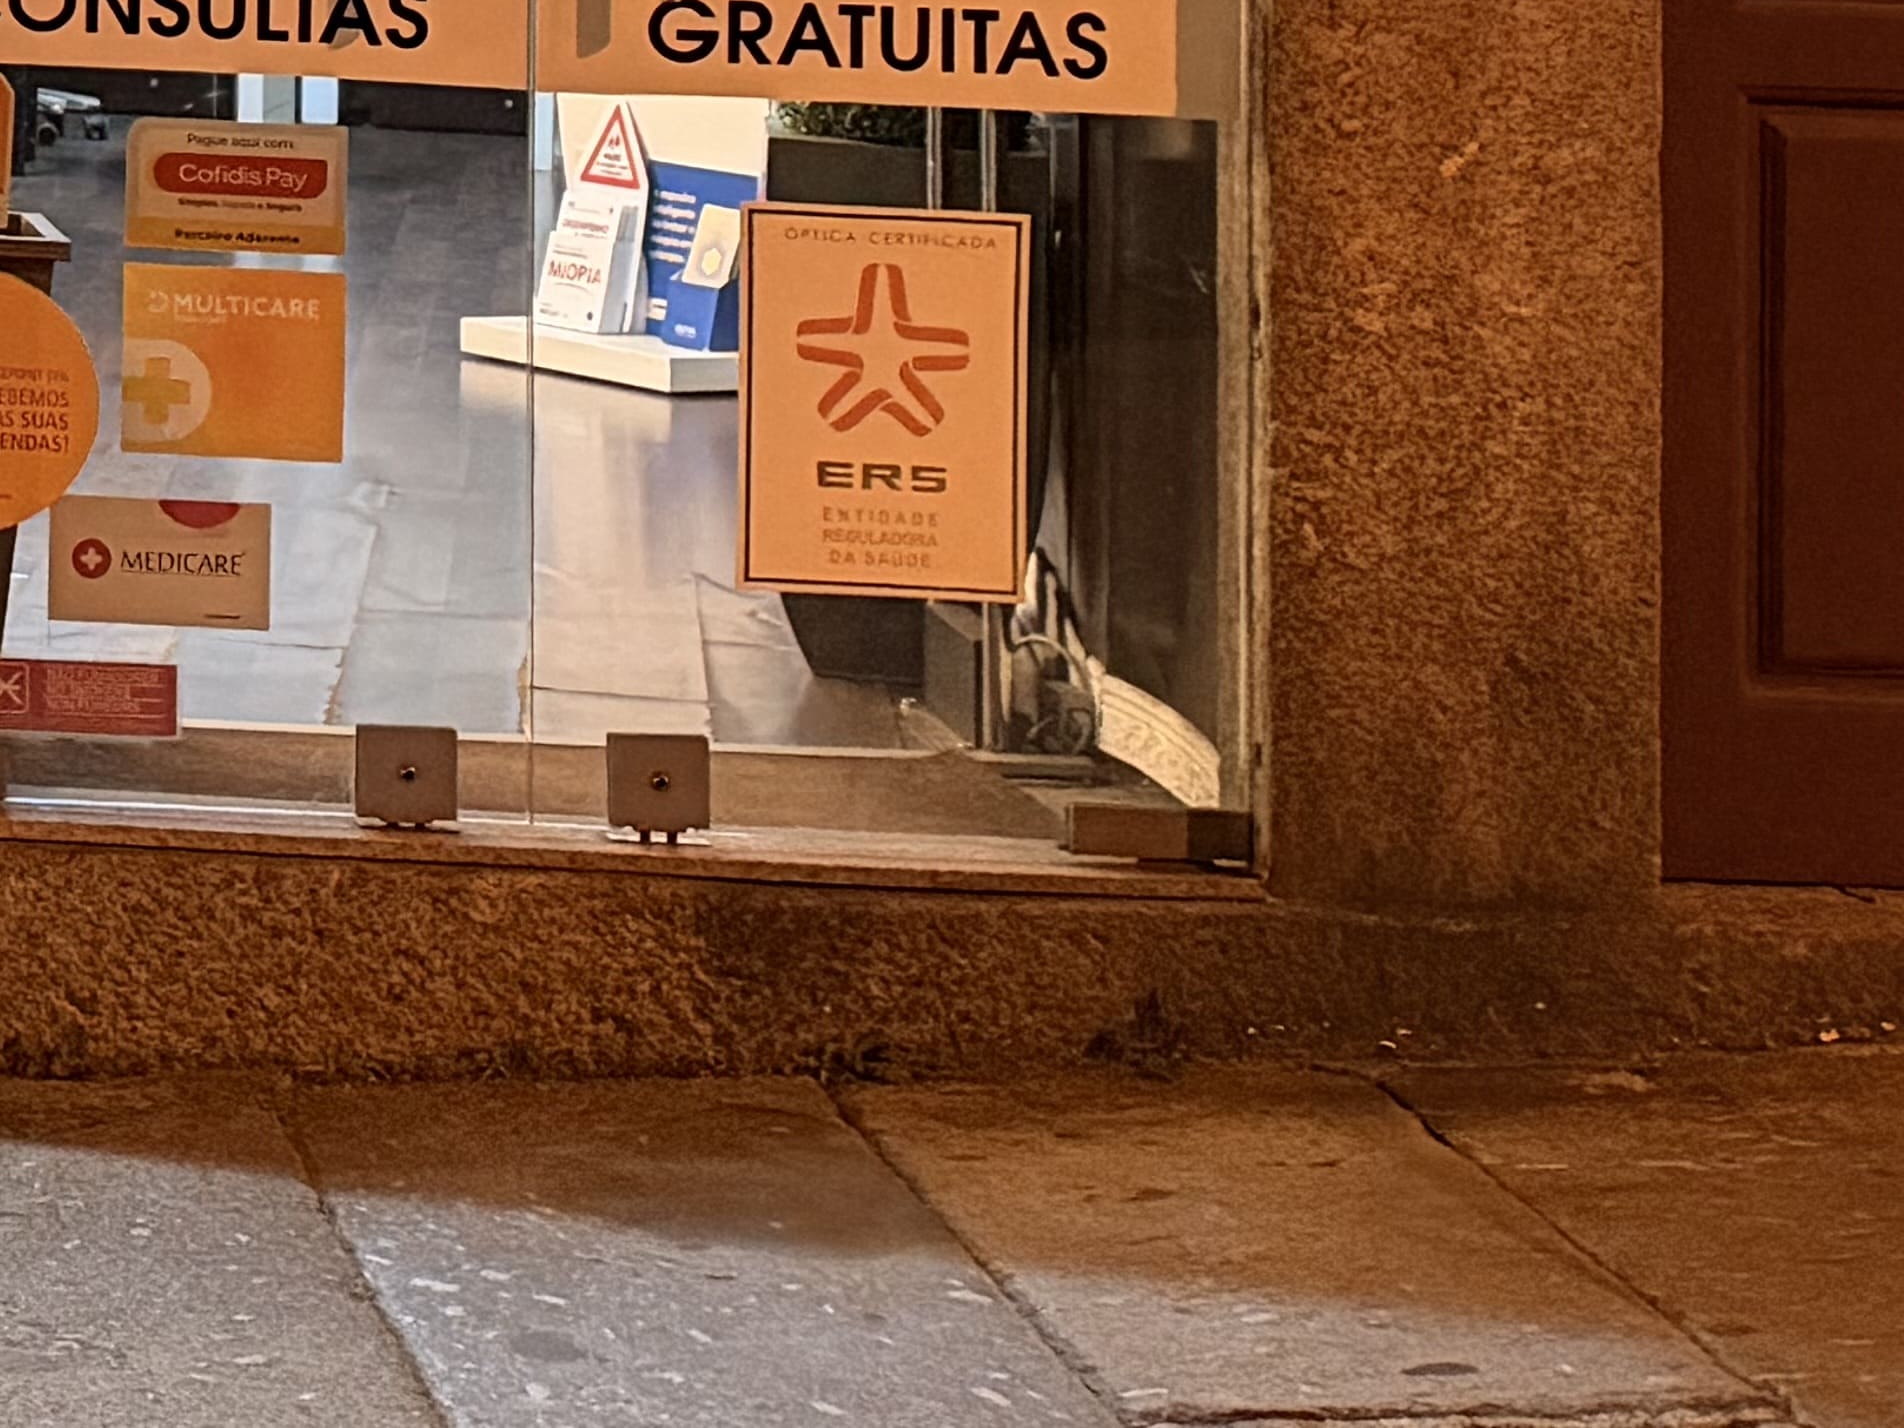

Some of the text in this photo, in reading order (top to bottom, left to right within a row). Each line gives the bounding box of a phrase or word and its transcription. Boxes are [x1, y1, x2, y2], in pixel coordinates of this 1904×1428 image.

[179, 163, 308, 192] Cofidis Pay
[868, 231, 996, 249] CERTIFICADA
[173, 294, 320, 320] MULTICARE
[21, 411, 68, 431] SUAS
[816, 461, 947, 493] ERS
[822, 506, 937, 527] ENTIDADE
[822, 528, 937, 546] REGULADORA
[120, 549, 244, 576] MEDICARE
[829, 549, 856, 564] DA
